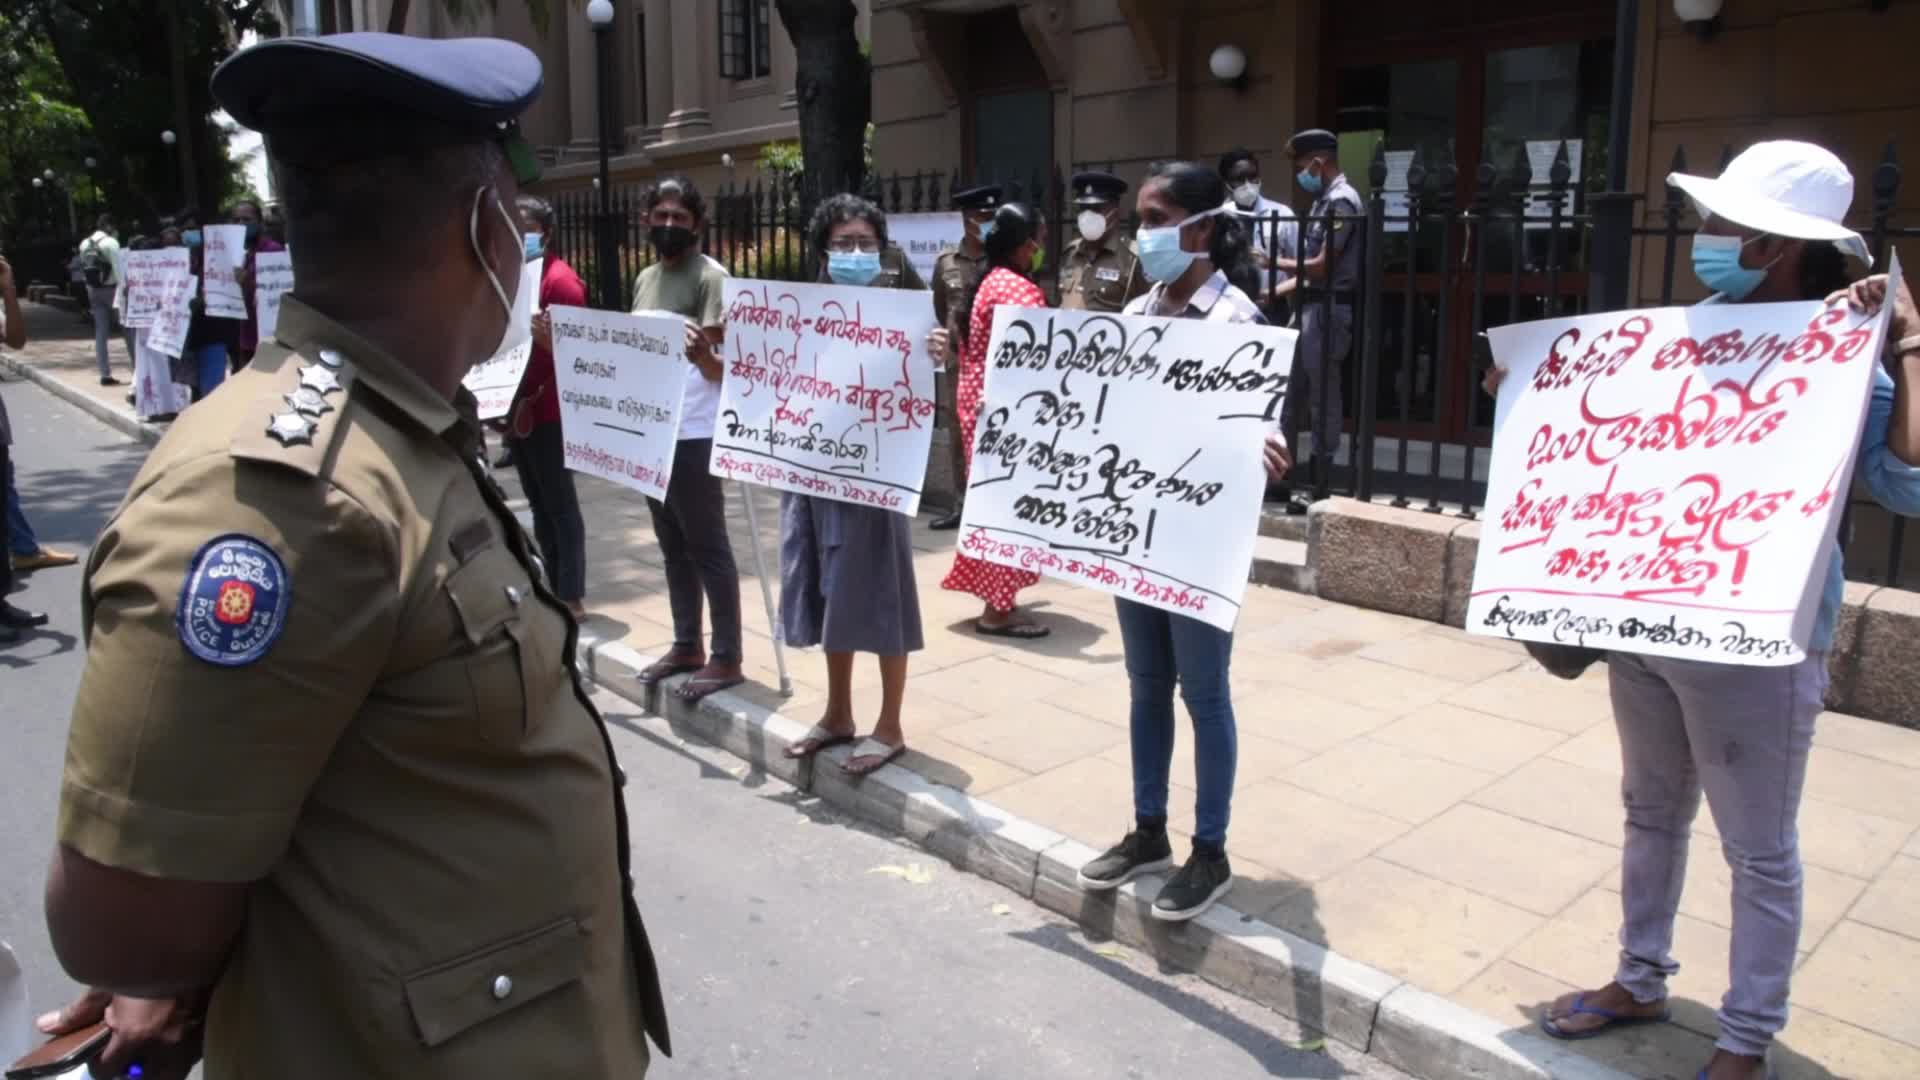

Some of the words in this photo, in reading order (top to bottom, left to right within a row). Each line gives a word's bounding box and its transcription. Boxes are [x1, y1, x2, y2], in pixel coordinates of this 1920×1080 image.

[994, 316, 1054, 371] තවත්
[1052, 316, 1171, 392] මැතිවරණ
[192, 597, 220, 647] POLICE
